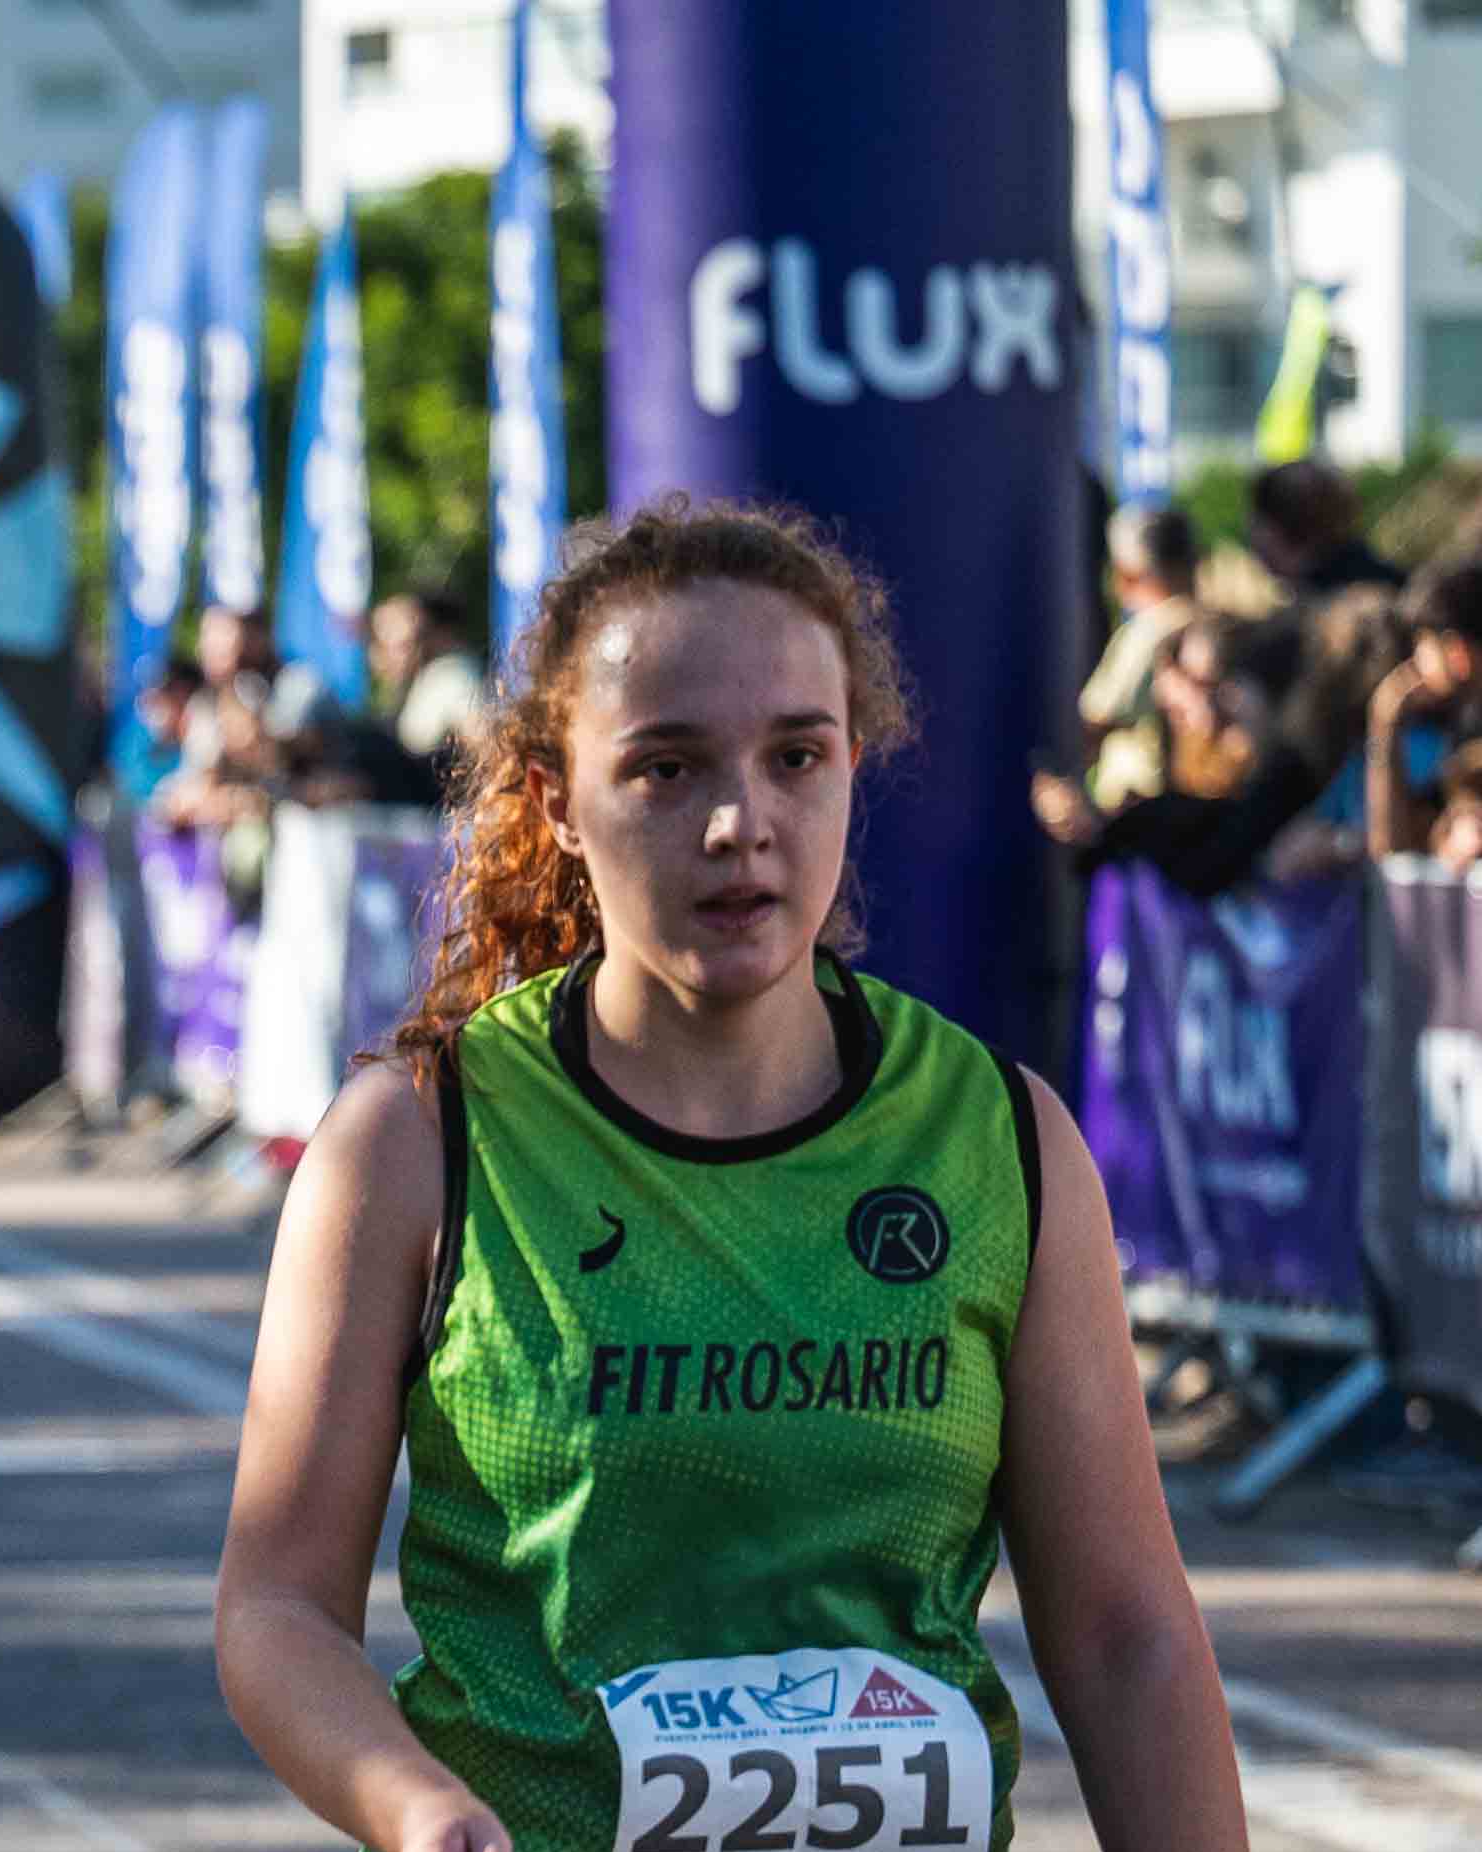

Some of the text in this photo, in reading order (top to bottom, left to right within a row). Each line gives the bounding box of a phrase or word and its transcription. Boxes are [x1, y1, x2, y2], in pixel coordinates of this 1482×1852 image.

[585, 1336, 949, 1416] FIT ROSARIO
[641, 1686, 747, 1730] 15K
[863, 1689, 916, 1712] 15K
